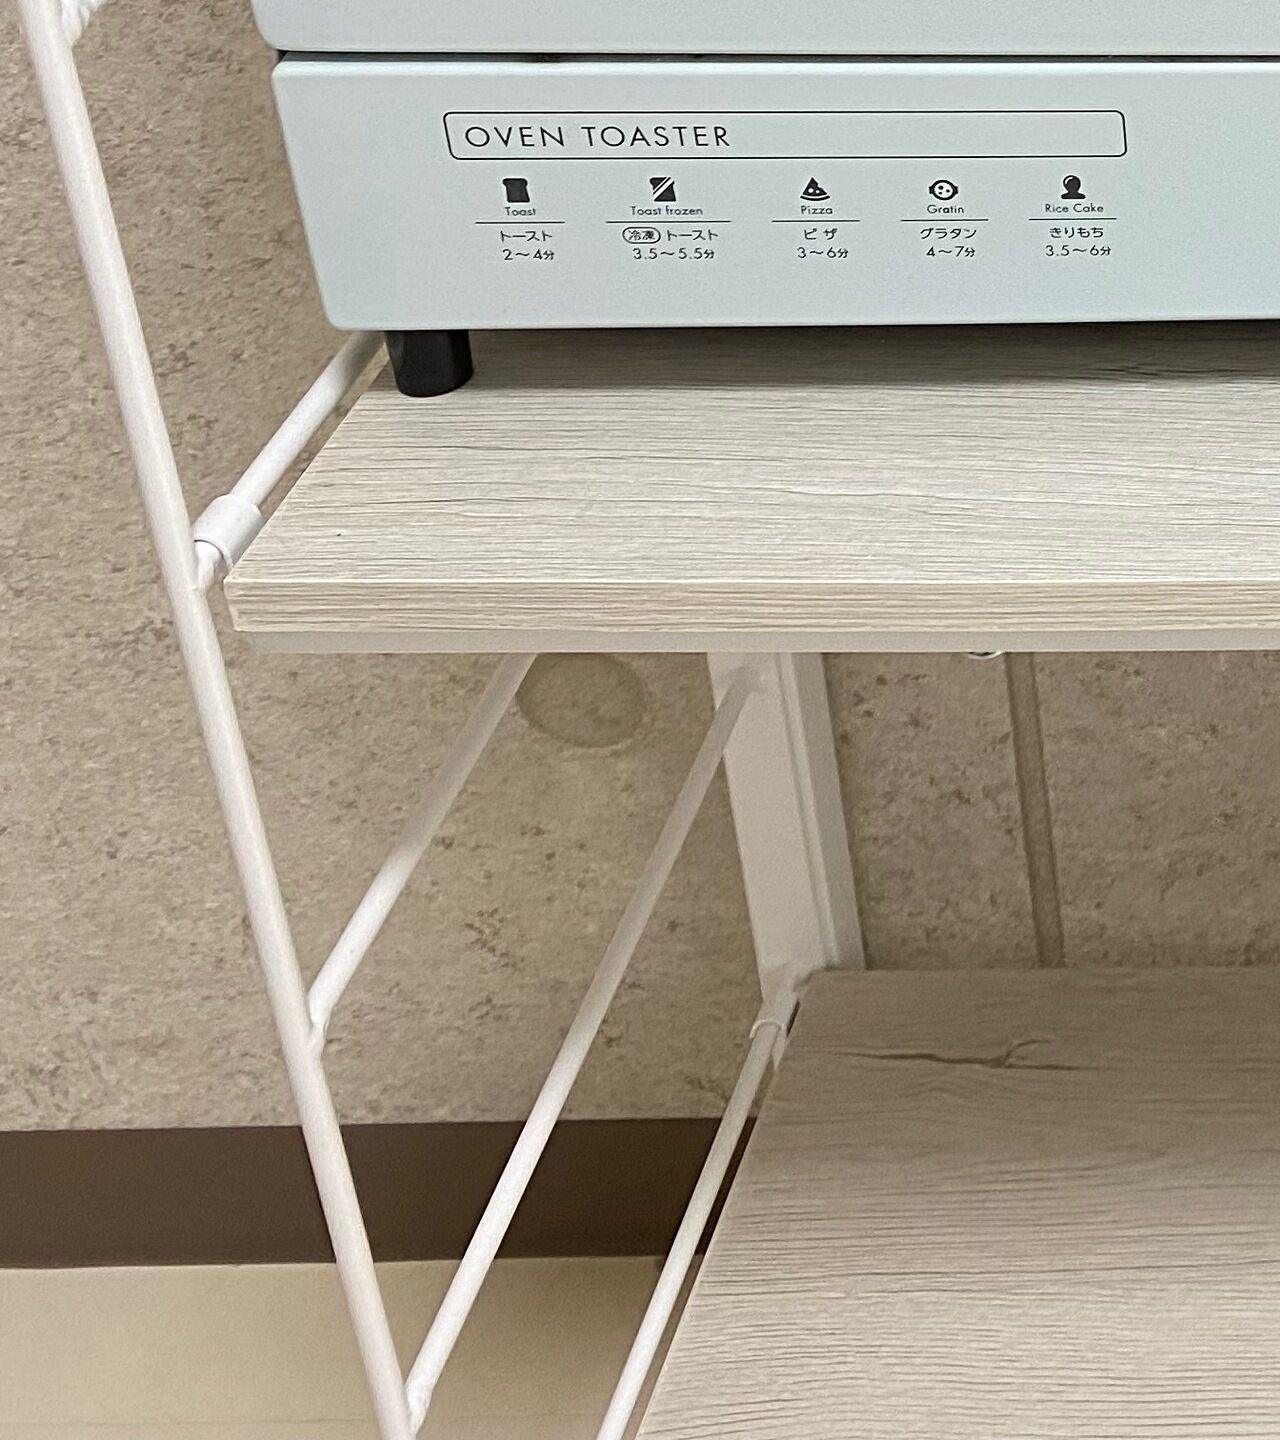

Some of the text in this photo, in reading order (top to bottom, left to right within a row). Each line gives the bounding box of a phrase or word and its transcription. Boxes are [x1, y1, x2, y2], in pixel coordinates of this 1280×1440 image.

[464, 125, 731, 148] OVEN TOASTER
[504, 206, 537, 217] Toast
[630, 205, 704, 216] Toast frozen
[801, 205, 834, 216] Pizza
[926, 204, 965, 215] Gratin
[1045, 203, 1105, 214] Rice Cake
[500, 230, 553, 242] トースト
[667, 229, 719, 242] トースト
[920, 227, 977, 240] グラタン
[1049, 226, 1105, 239] きりもち
